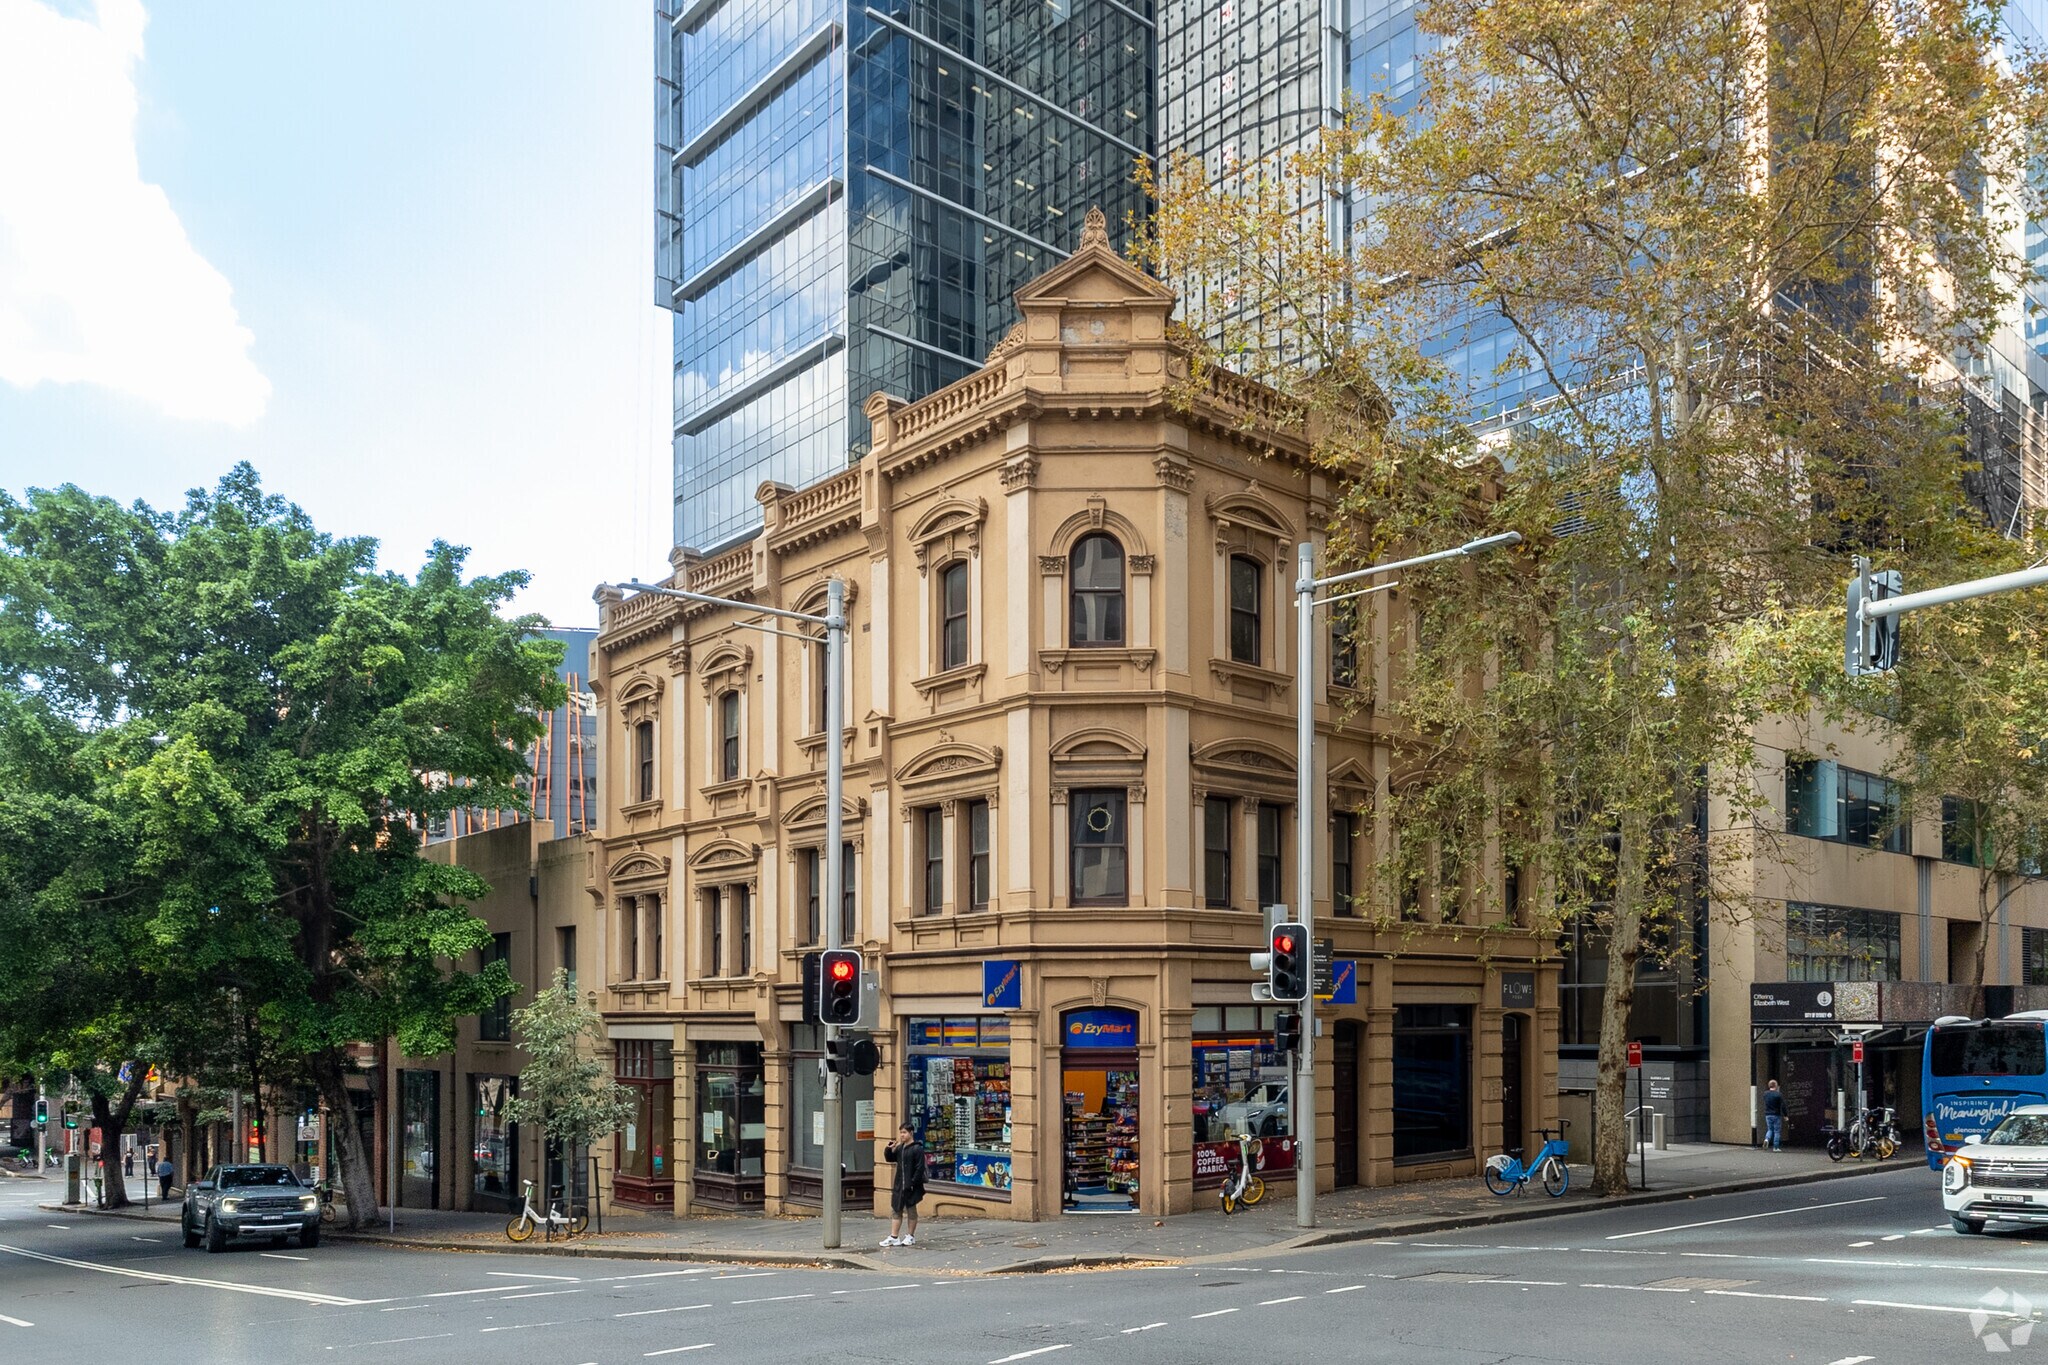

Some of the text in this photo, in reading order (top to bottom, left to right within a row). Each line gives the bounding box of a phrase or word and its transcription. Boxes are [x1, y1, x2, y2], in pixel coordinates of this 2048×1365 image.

[993, 963, 1018, 998] EzyMart
[1083, 1023, 1132, 1036] EzyMart
[1936, 1100, 2009, 1126] Meaningful
[1197, 1149, 1216, 1158] 100%
[1197, 1156, 1225, 1166] COFFEE
[1197, 1164, 1228, 1175] ARABICA
